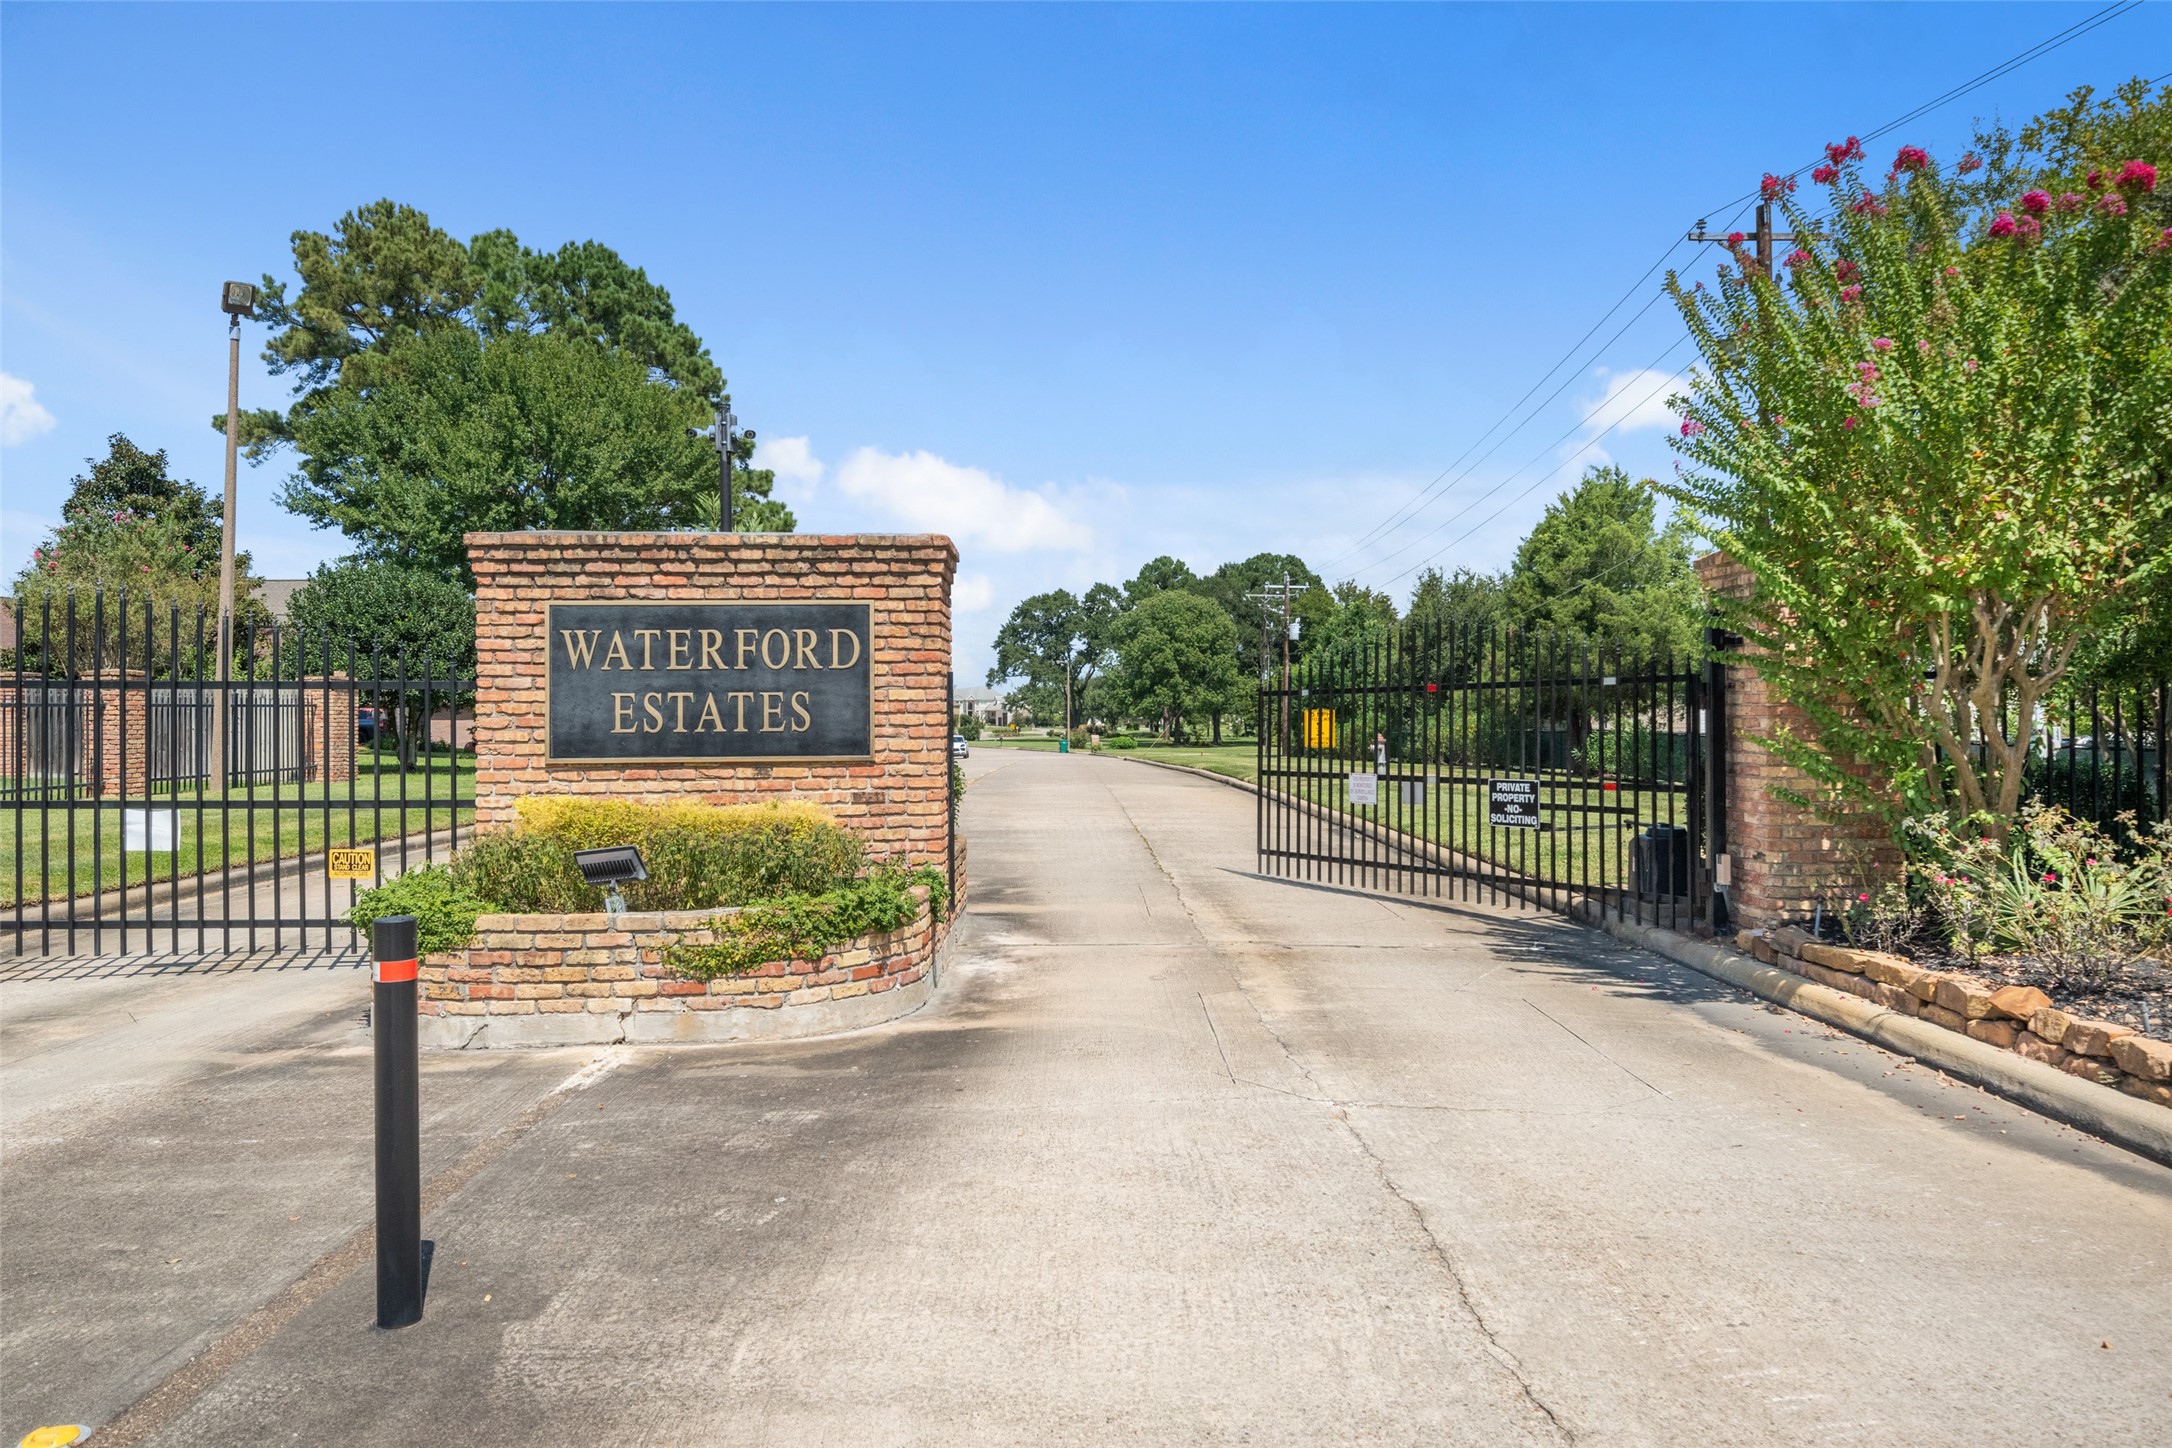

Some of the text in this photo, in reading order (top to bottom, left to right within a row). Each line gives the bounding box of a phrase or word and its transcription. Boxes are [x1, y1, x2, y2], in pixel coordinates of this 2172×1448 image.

[559, 628, 861, 671] WATERFORD
[610, 691, 812, 734] ESTATES
[1496, 782, 1530, 792] PRIVATE
[1492, 793, 1535, 803] PROPERTY
[1490, 813, 1538, 825] SOLICITING
[333, 853, 370, 864] CAUTION
